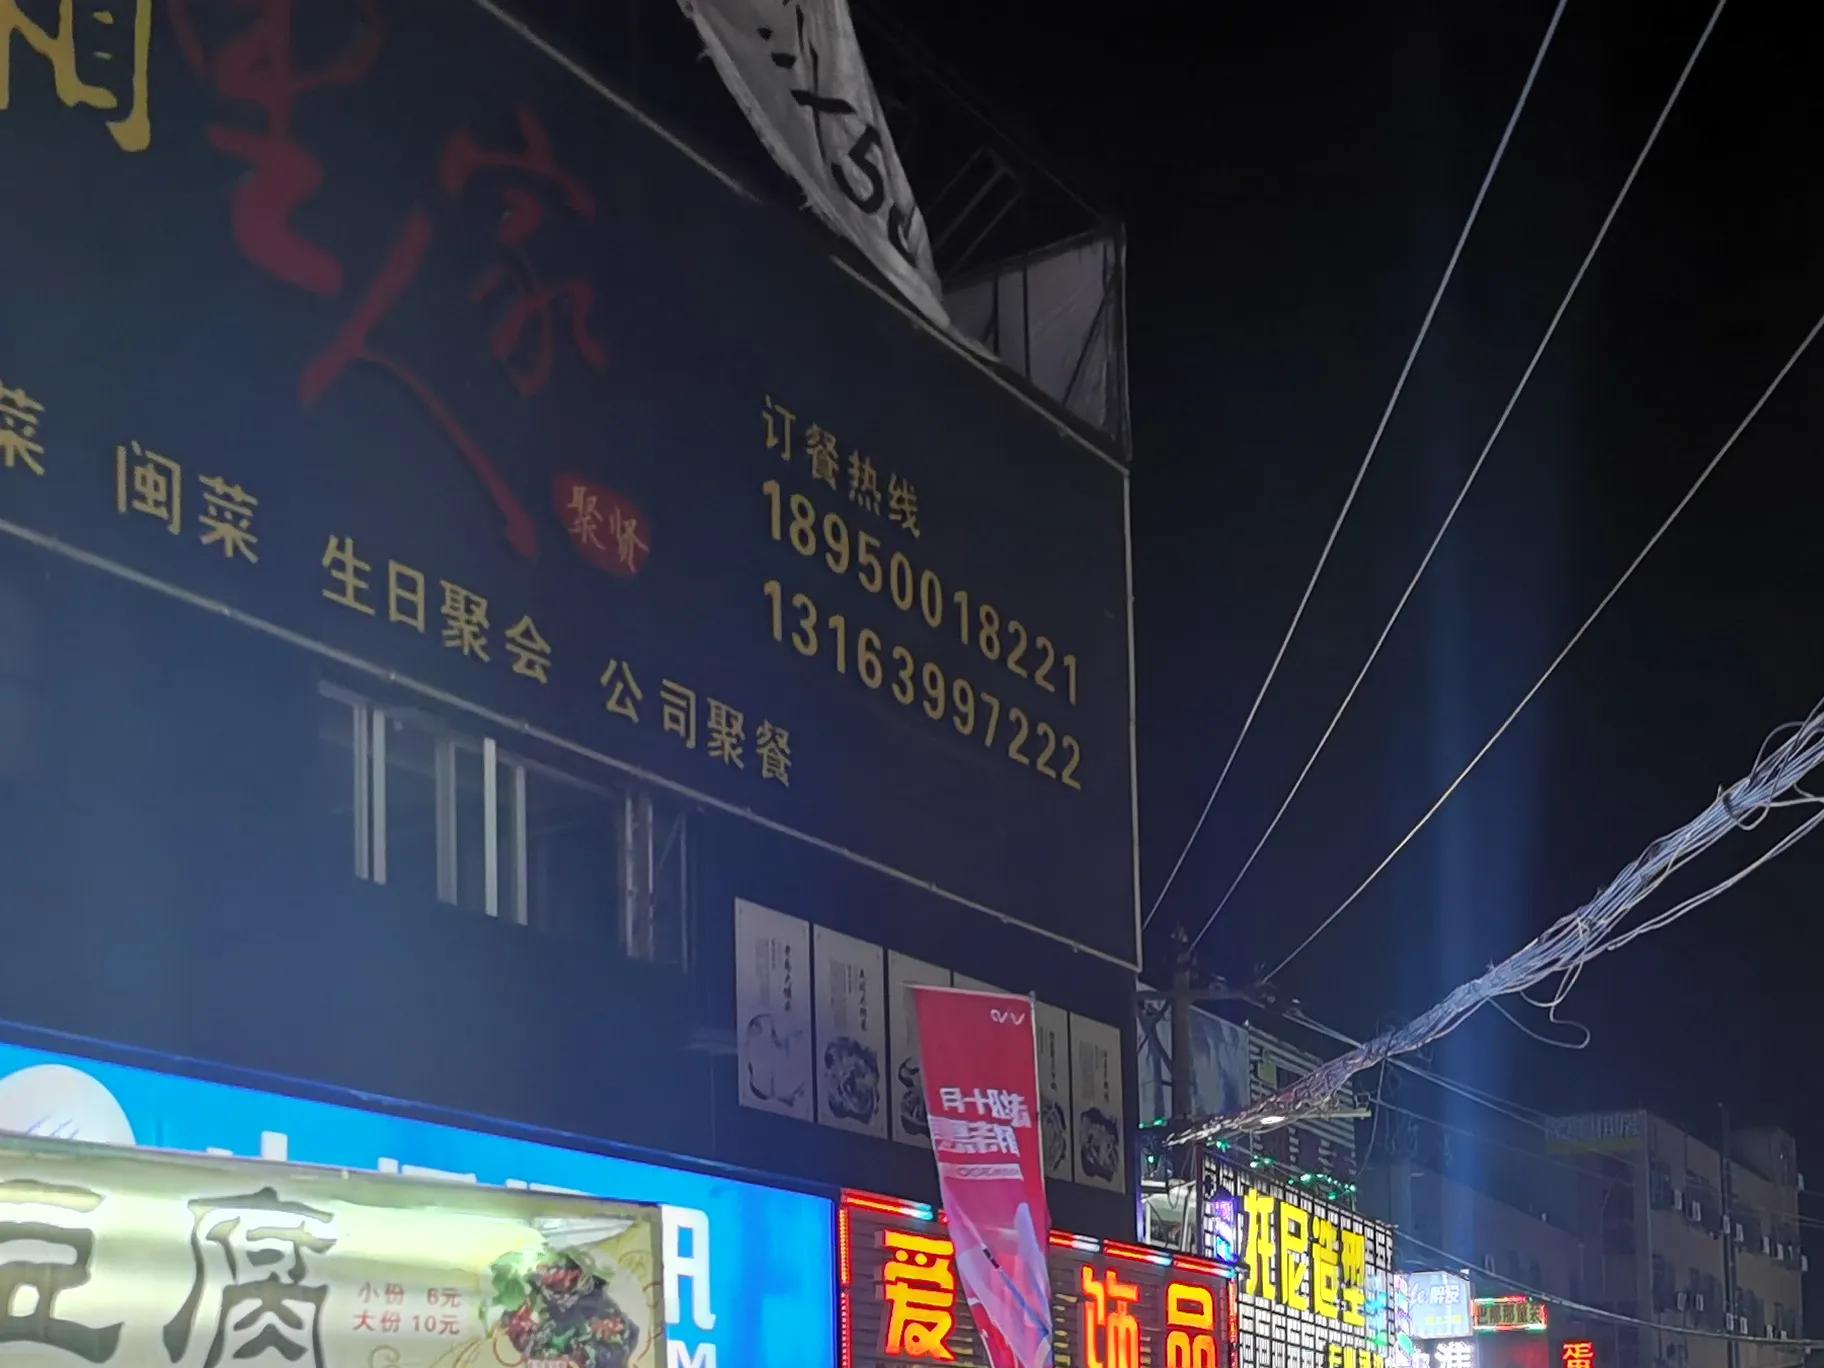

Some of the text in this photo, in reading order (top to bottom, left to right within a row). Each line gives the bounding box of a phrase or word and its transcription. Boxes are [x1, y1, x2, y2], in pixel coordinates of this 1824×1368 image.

[116, 440, 260, 564] 闽菜
[566, 485, 650, 572] 聚贤
[762, 394, 921, 539] 订餐热线
[321, 535, 553, 685] 生日聚会
[762, 479, 1078, 705] 18950018221
[599, 658, 794, 788] 公司聚餐
[763, 579, 1082, 790] 13163997222
[412, 1314, 461, 1336] 10元
